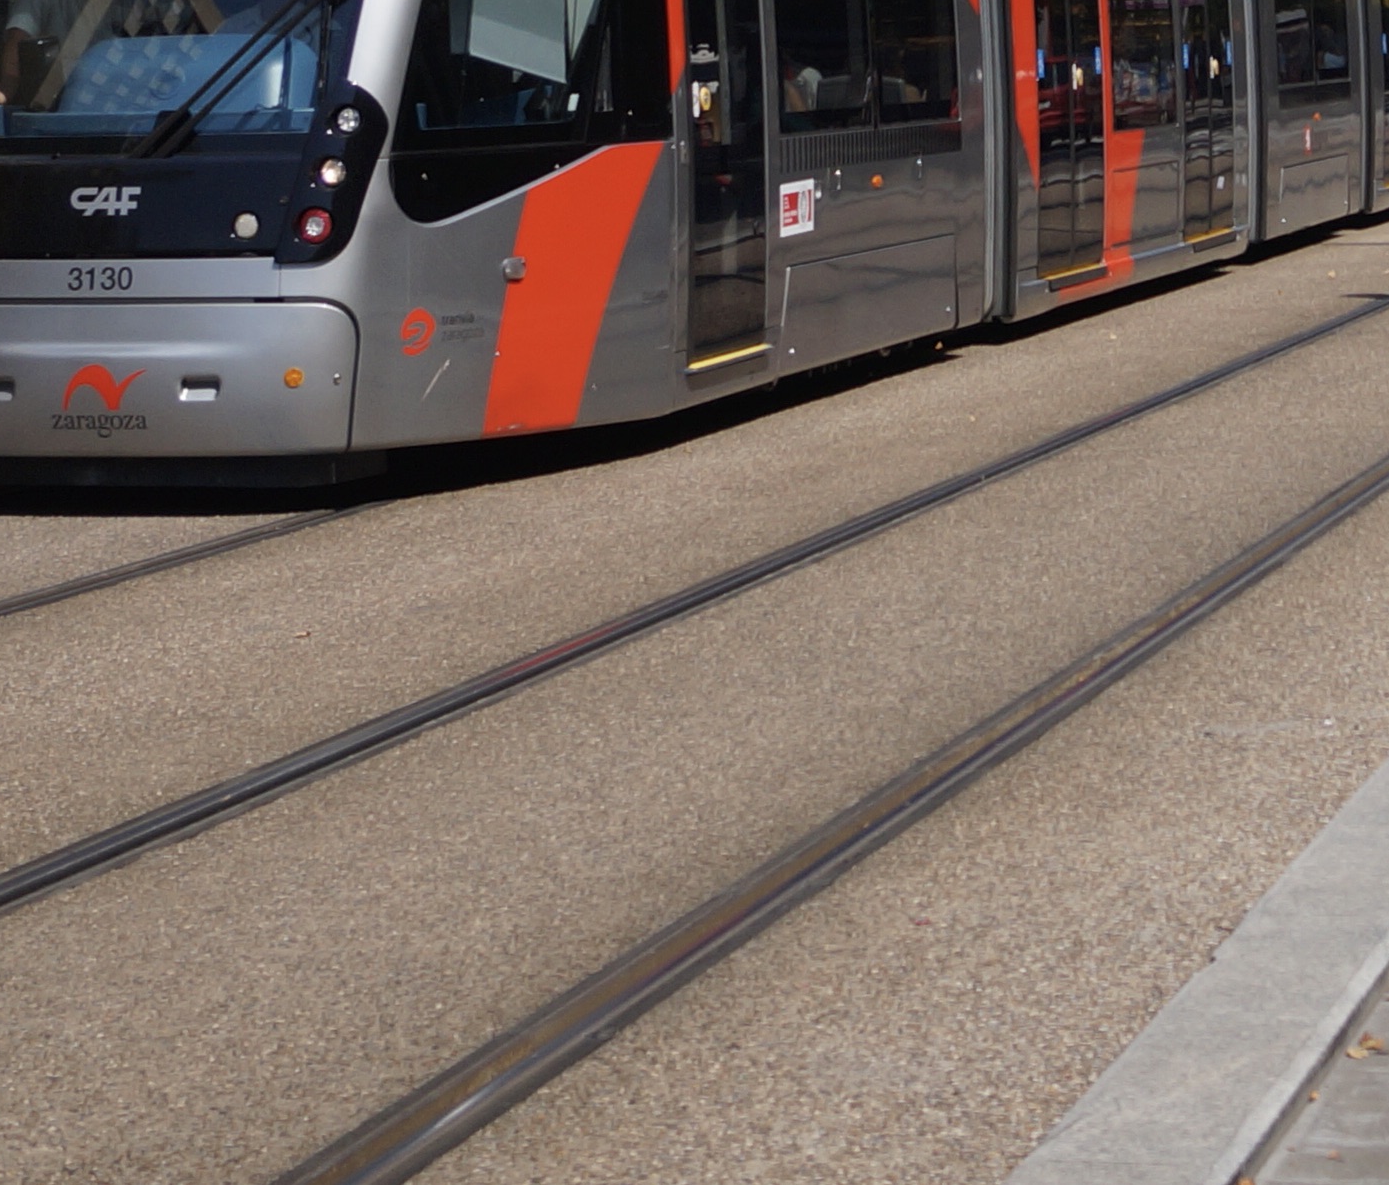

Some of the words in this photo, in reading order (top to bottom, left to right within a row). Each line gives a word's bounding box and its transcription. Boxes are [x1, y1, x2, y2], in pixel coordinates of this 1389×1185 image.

[70, 186, 142, 216] CAF
[67, 266, 133, 291] 3130
[52, 414, 147, 438] zaragoza
